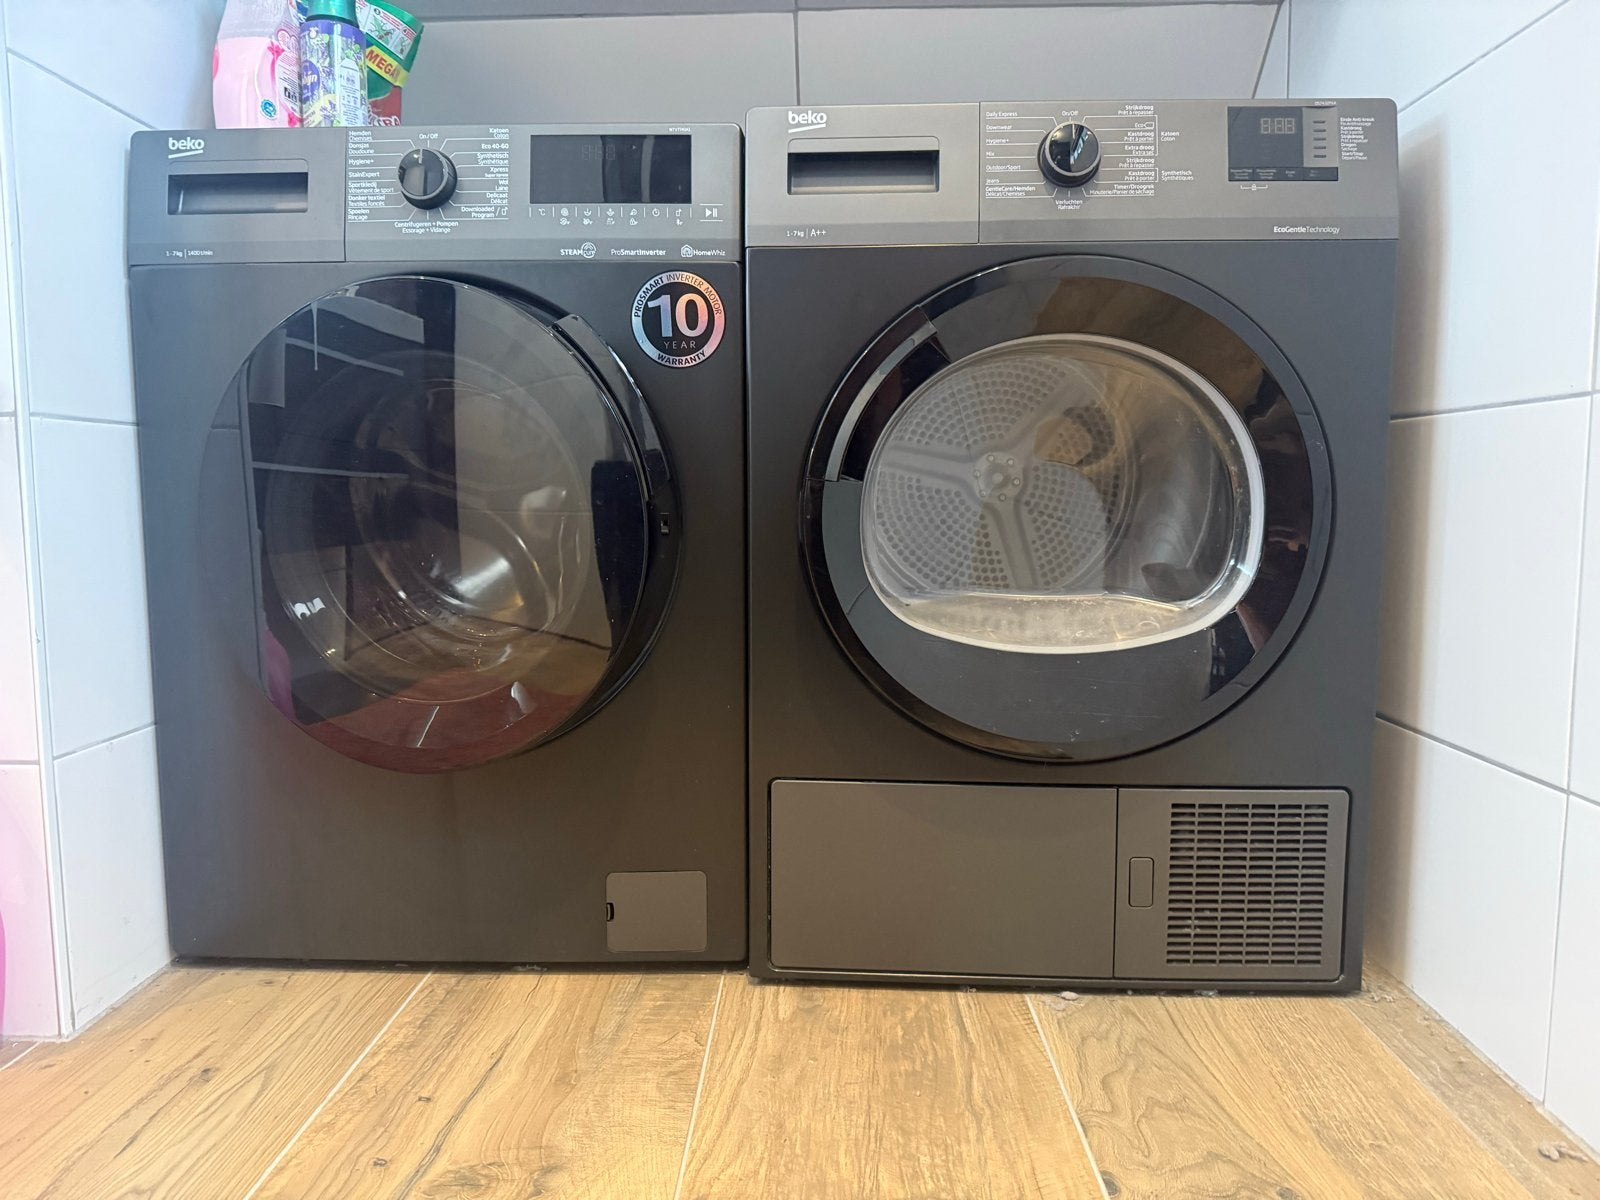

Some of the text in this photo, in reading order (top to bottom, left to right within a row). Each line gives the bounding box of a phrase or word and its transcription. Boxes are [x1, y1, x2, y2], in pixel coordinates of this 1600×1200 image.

[788, 110, 827, 124] beko
[168, 137, 204, 150] beko
[810, 228, 827, 237] A++
[1274, 226, 1340, 234] EcoGentleTechnology
[634, 273, 722, 318] PROSMART INVERTER MOTOR
[647, 293, 708, 338] 10
[664, 340, 696, 349] YEAR
[657, 350, 706, 365] WARRANTY
